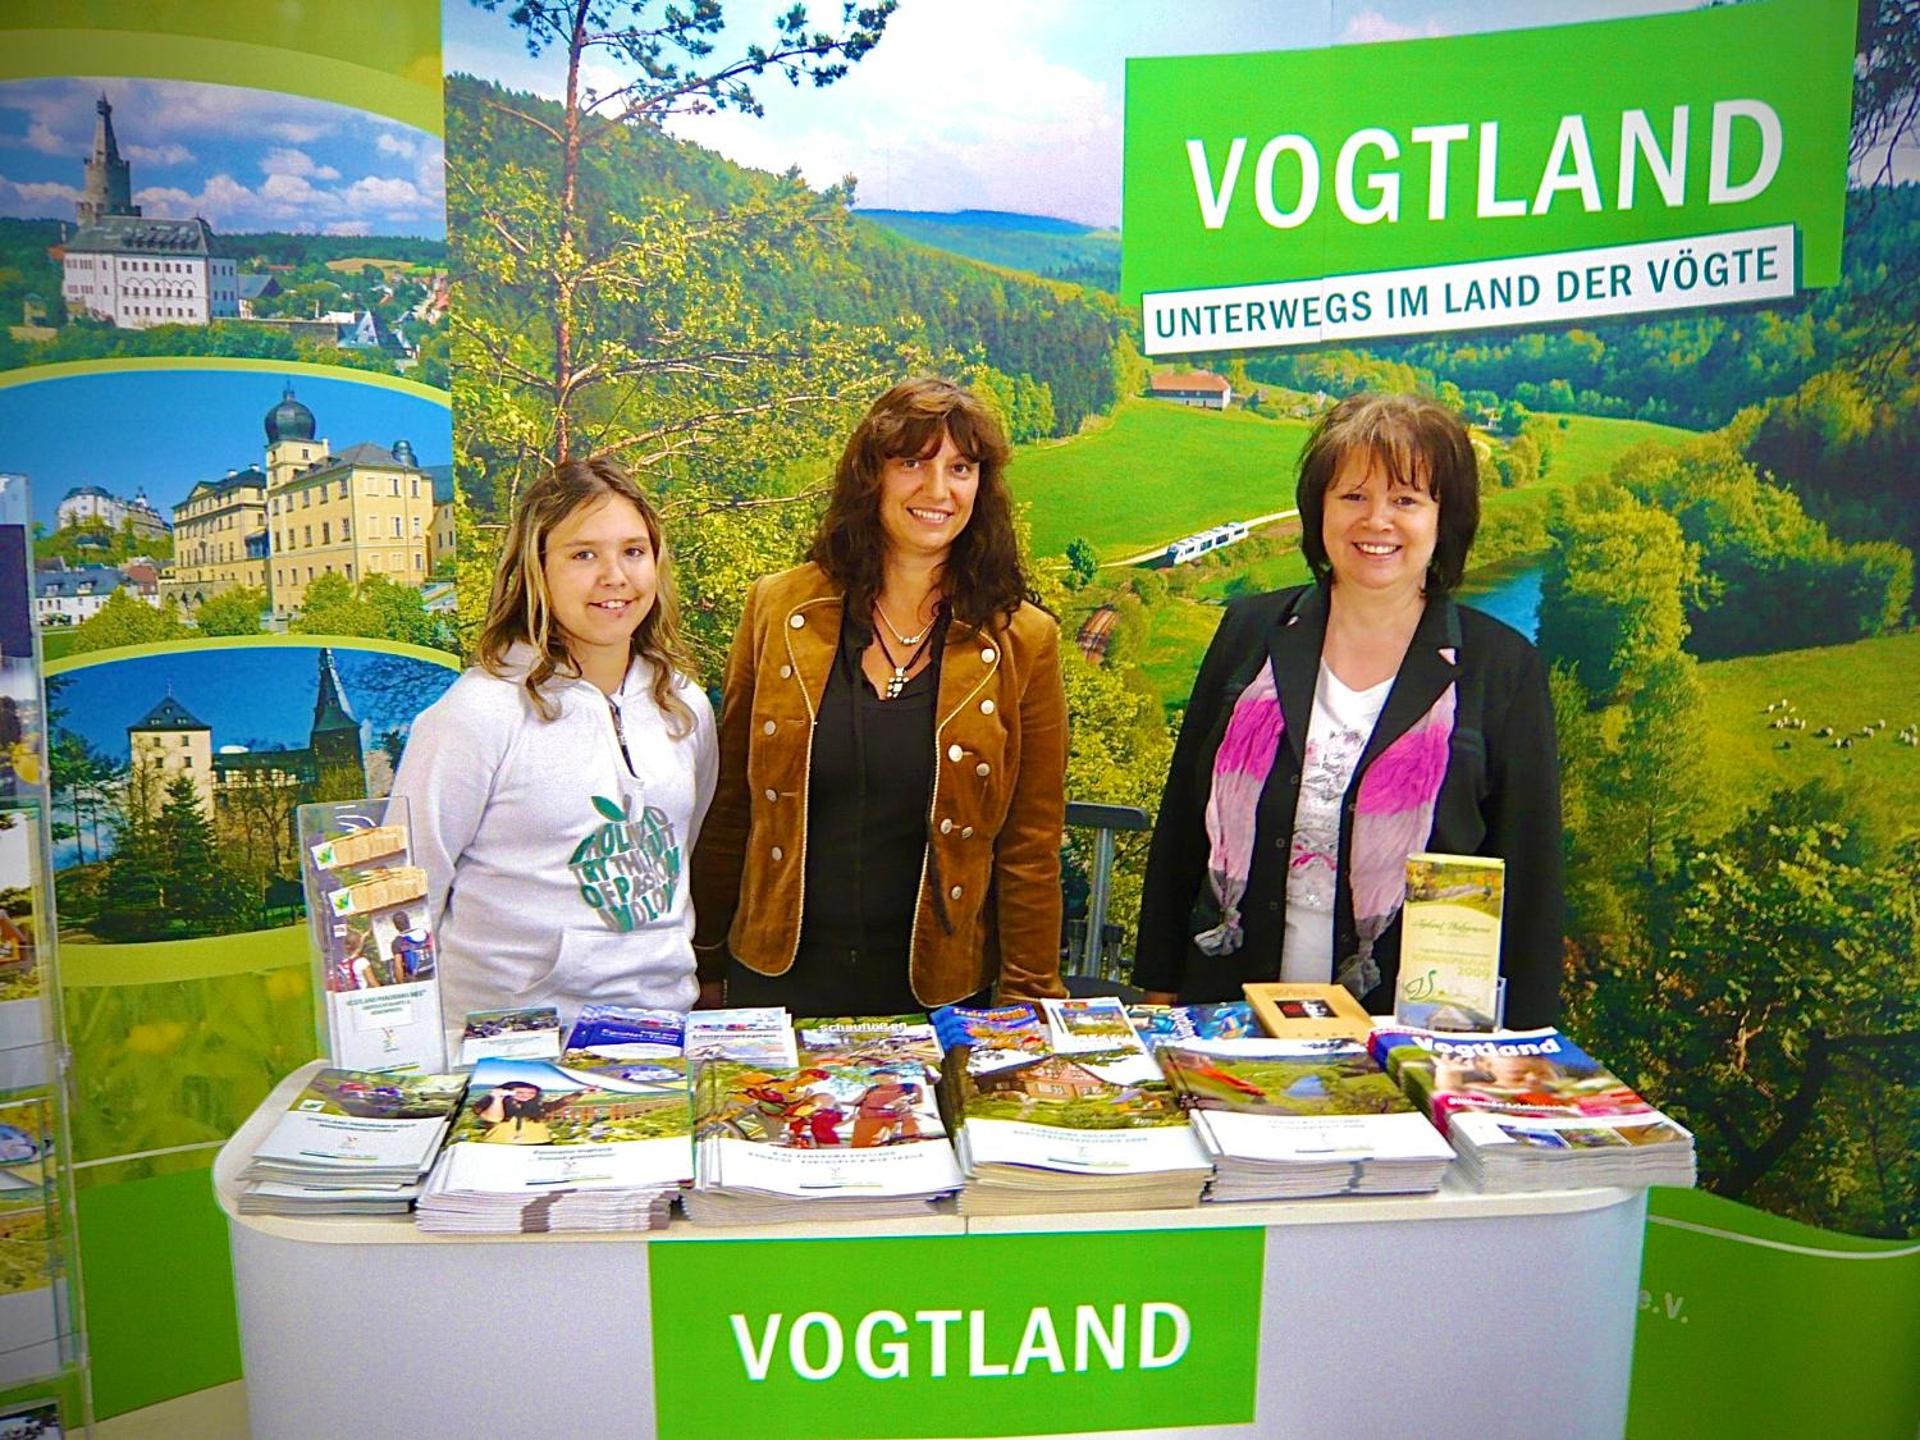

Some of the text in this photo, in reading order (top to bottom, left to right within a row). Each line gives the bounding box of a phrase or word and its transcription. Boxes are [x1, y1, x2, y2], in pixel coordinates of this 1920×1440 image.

[1186, 99, 1783, 229] VOGTLAND
[1156, 246, 1778, 338] UNTERWEGS IM LAND DER VÖGTE
[1412, 1036, 1562, 1058] Vogtland
[730, 1302, 1191, 1380] VOGTLAND
